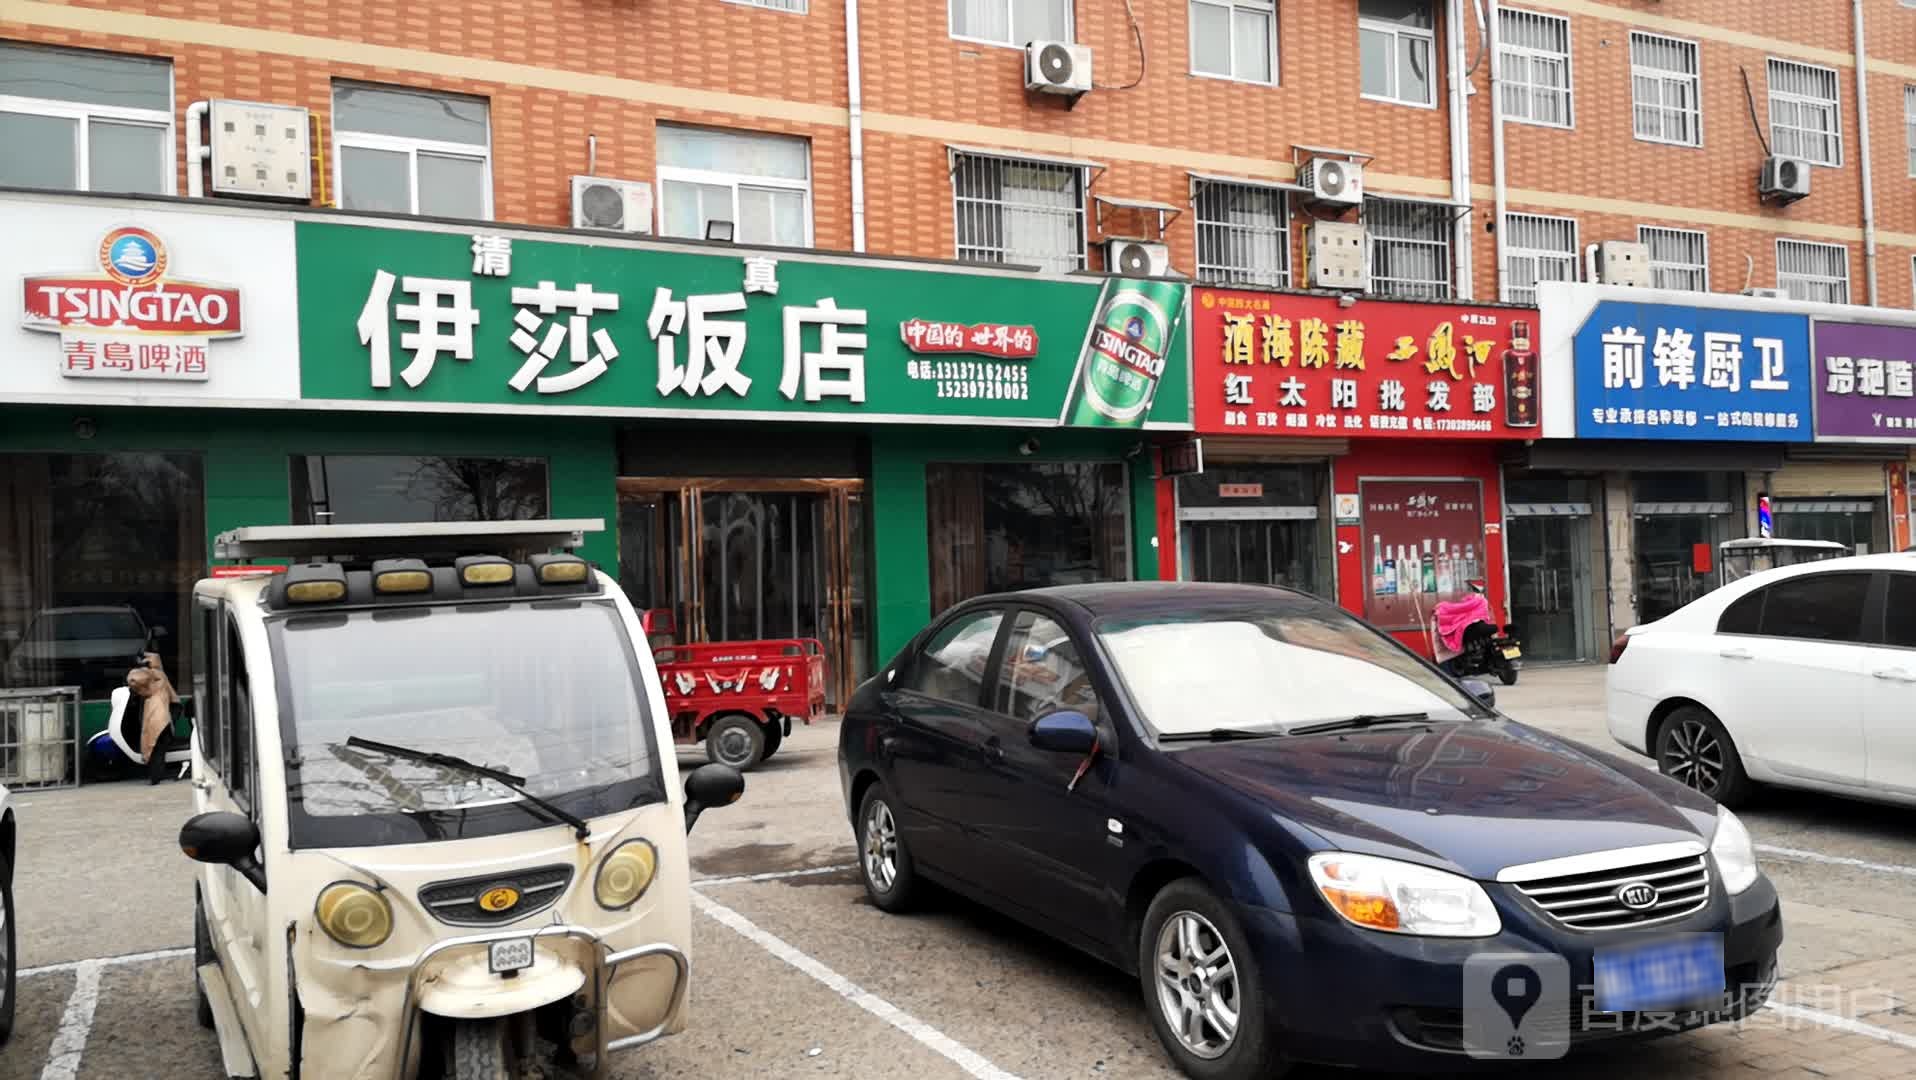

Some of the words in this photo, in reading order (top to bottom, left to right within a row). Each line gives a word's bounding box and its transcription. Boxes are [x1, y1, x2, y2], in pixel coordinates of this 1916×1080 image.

[472, 235, 513, 276] 清
[743, 256, 779, 295] 真
[38, 284, 229, 325] TSINGTAO
[63, 339, 208, 374] 青島啤酒
[357, 269, 868, 404] 伊莎饭店
[907, 321, 964, 348] 中国的
[970, 326, 1033, 353] 世界的
[1095, 328, 1165, 378] TSINGTAO
[1222, 311, 1366, 371] 酒海陈藏
[1601, 326, 1790, 393] 前锋厨卫
[1223, 373, 1497, 414] 红太阳批发部
[1256, 412, 1278, 427] 百货
[1315, 414, 1337, 428] 冷饮
[1625, 887, 1653, 905] KIA
